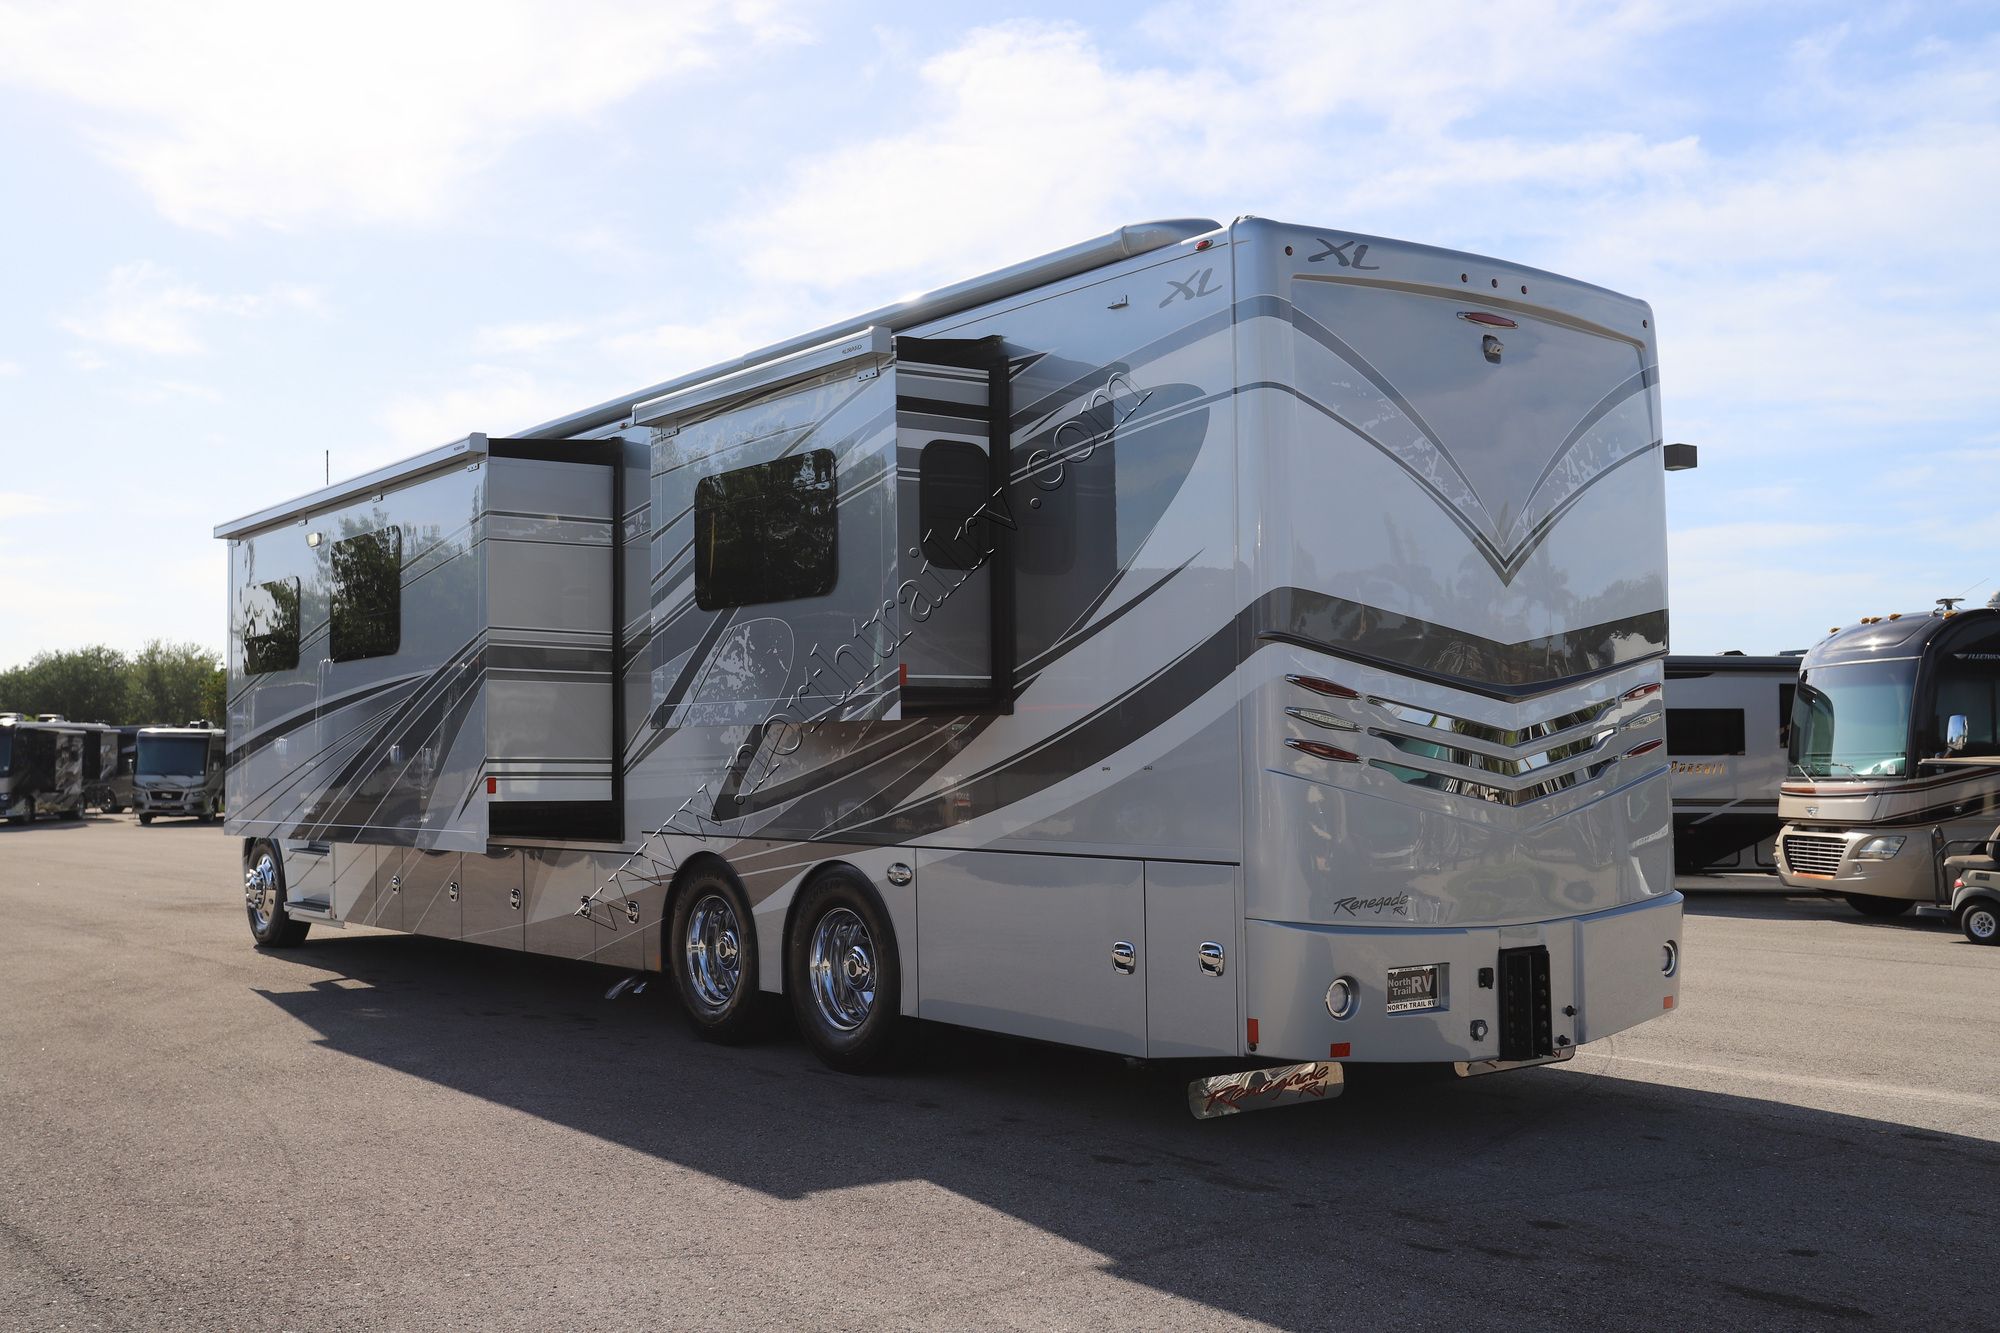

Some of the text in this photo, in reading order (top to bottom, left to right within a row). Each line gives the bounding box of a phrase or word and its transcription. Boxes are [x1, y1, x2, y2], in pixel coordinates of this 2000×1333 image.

[1308, 238, 1380, 270] XL
[1159, 268, 1223, 308] XL
[1333, 891, 1409, 917] Renegade
[1388, 977, 1411, 988] North
[1392, 986, 1411, 996] Trail
[1411, 975, 1433, 994] RV
[1387, 1002, 1408, 1012] NORTH
[1409, 1000, 1426, 1009] TRAIL
[1427, 999, 1436, 1007] RV
[1204, 1062, 1329, 1112] Renegade
